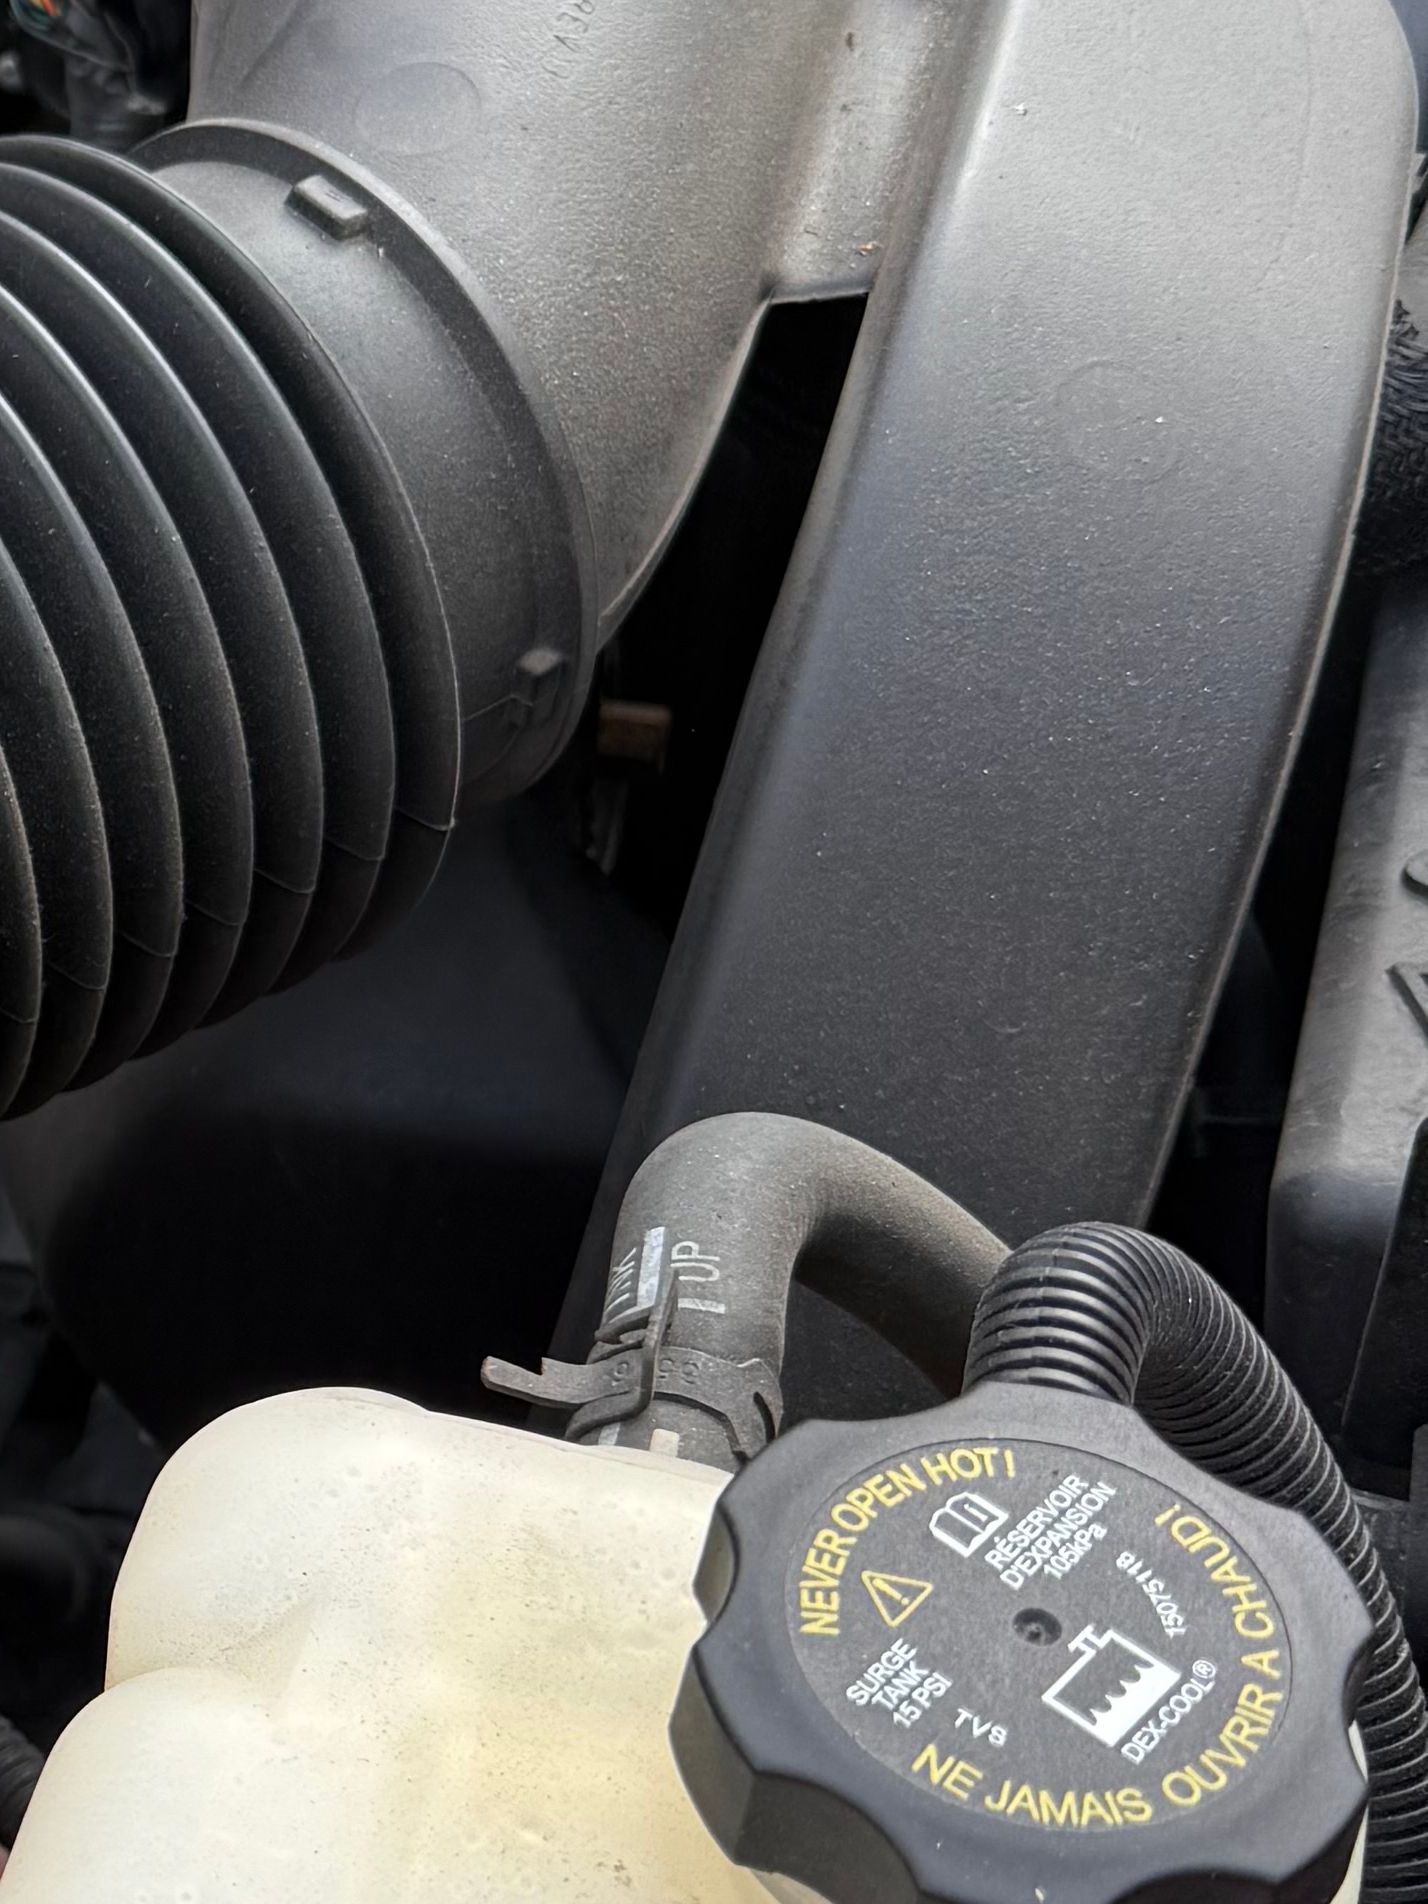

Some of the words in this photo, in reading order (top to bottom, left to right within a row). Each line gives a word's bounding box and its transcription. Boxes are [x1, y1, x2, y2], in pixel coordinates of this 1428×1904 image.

[799, 1527, 858, 1636] NEVER
[830, 1462, 927, 1533] OPEN
[984, 1473, 1089, 1572] RÉSERVOIR
[999, 1481, 1117, 1591] D'EXPANSION
[1043, 1521, 1108, 1580] 105kPa
[1115, 1551, 1188, 1639] 15075118
[1153, 1503, 1275, 1639] CHAUD!
[846, 1638, 917, 1706] SURGE
[871, 1659, 930, 1711] TANK
[1240, 1648, 1282, 1680] A
[893, 1699, 923, 1729] 15
[910, 1671, 954, 1709] PSI
[911, 1742, 983, 1802] NE
[1161, 1683, 1284, 1807] OUVRIR
[985, 1778, 1154, 1828] JAMAIS
